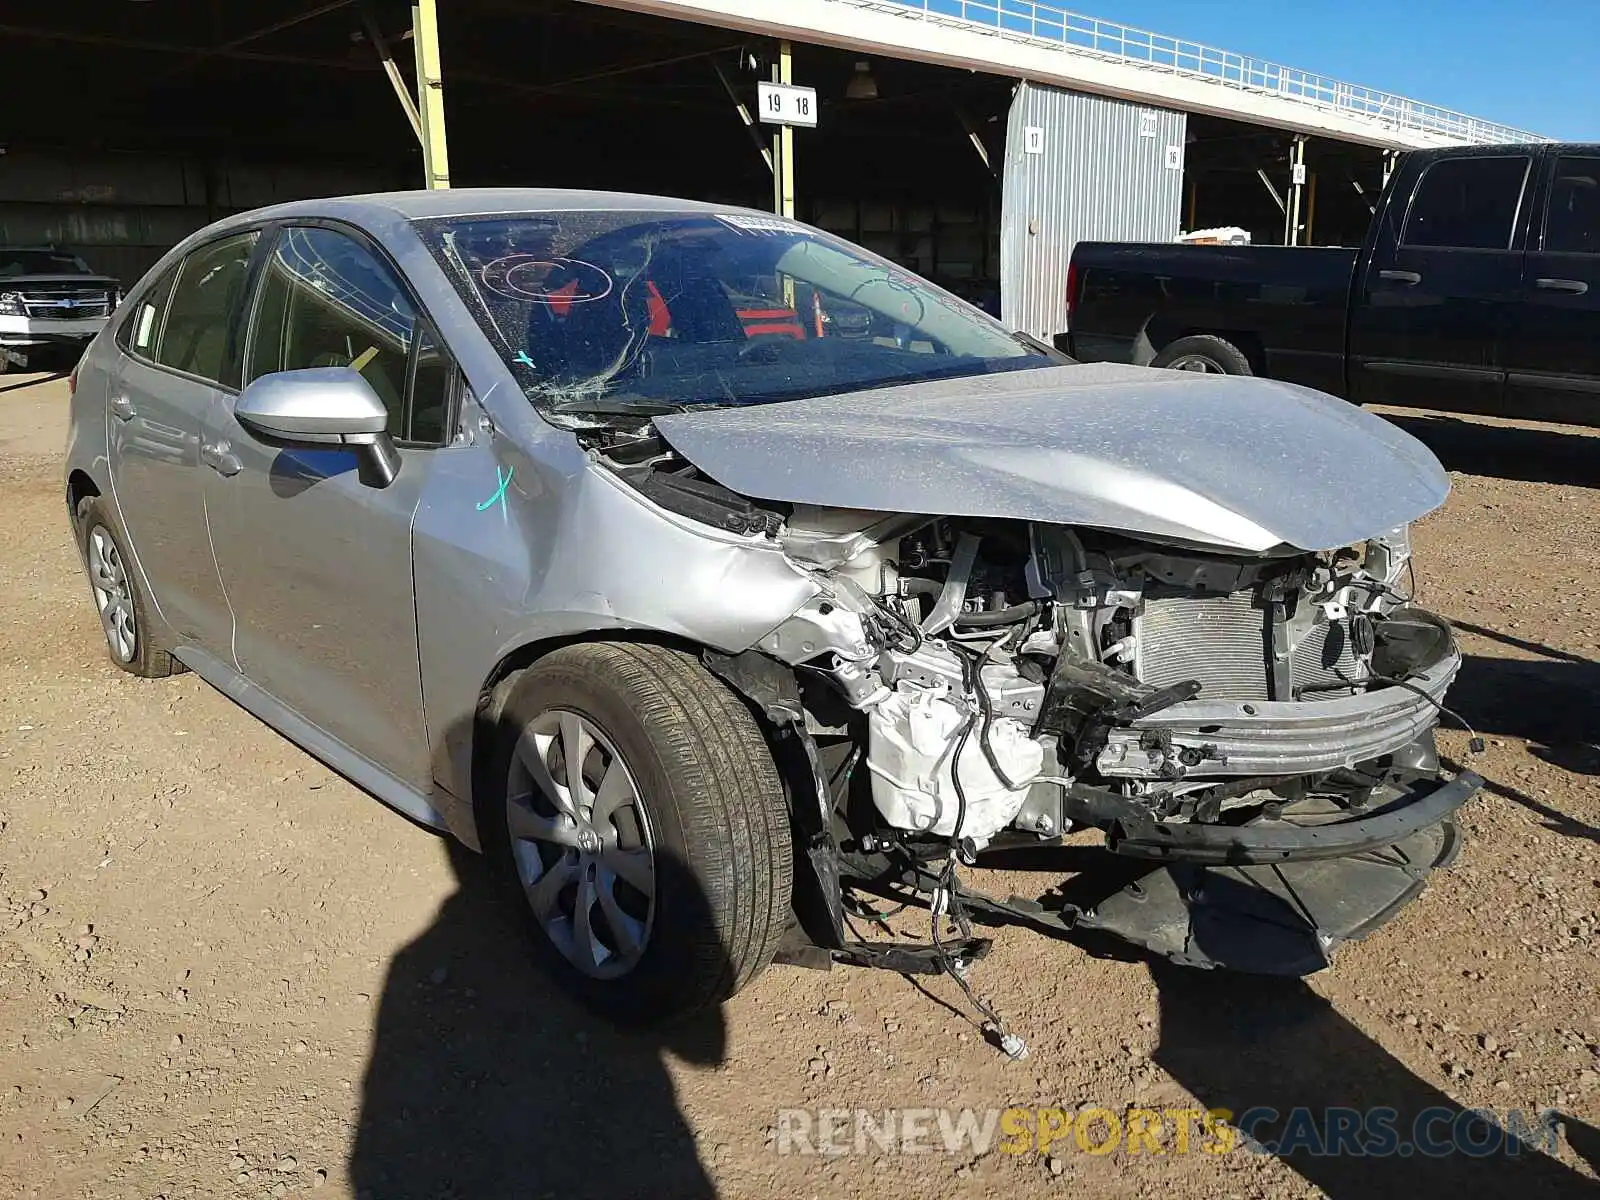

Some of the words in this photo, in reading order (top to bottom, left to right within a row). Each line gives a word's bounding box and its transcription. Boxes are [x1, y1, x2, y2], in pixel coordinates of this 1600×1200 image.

[767, 93, 781, 113] 19
[795, 96, 809, 116] 18
[1031, 132, 1039, 149] 17
[1169, 151, 1177, 165] 16
